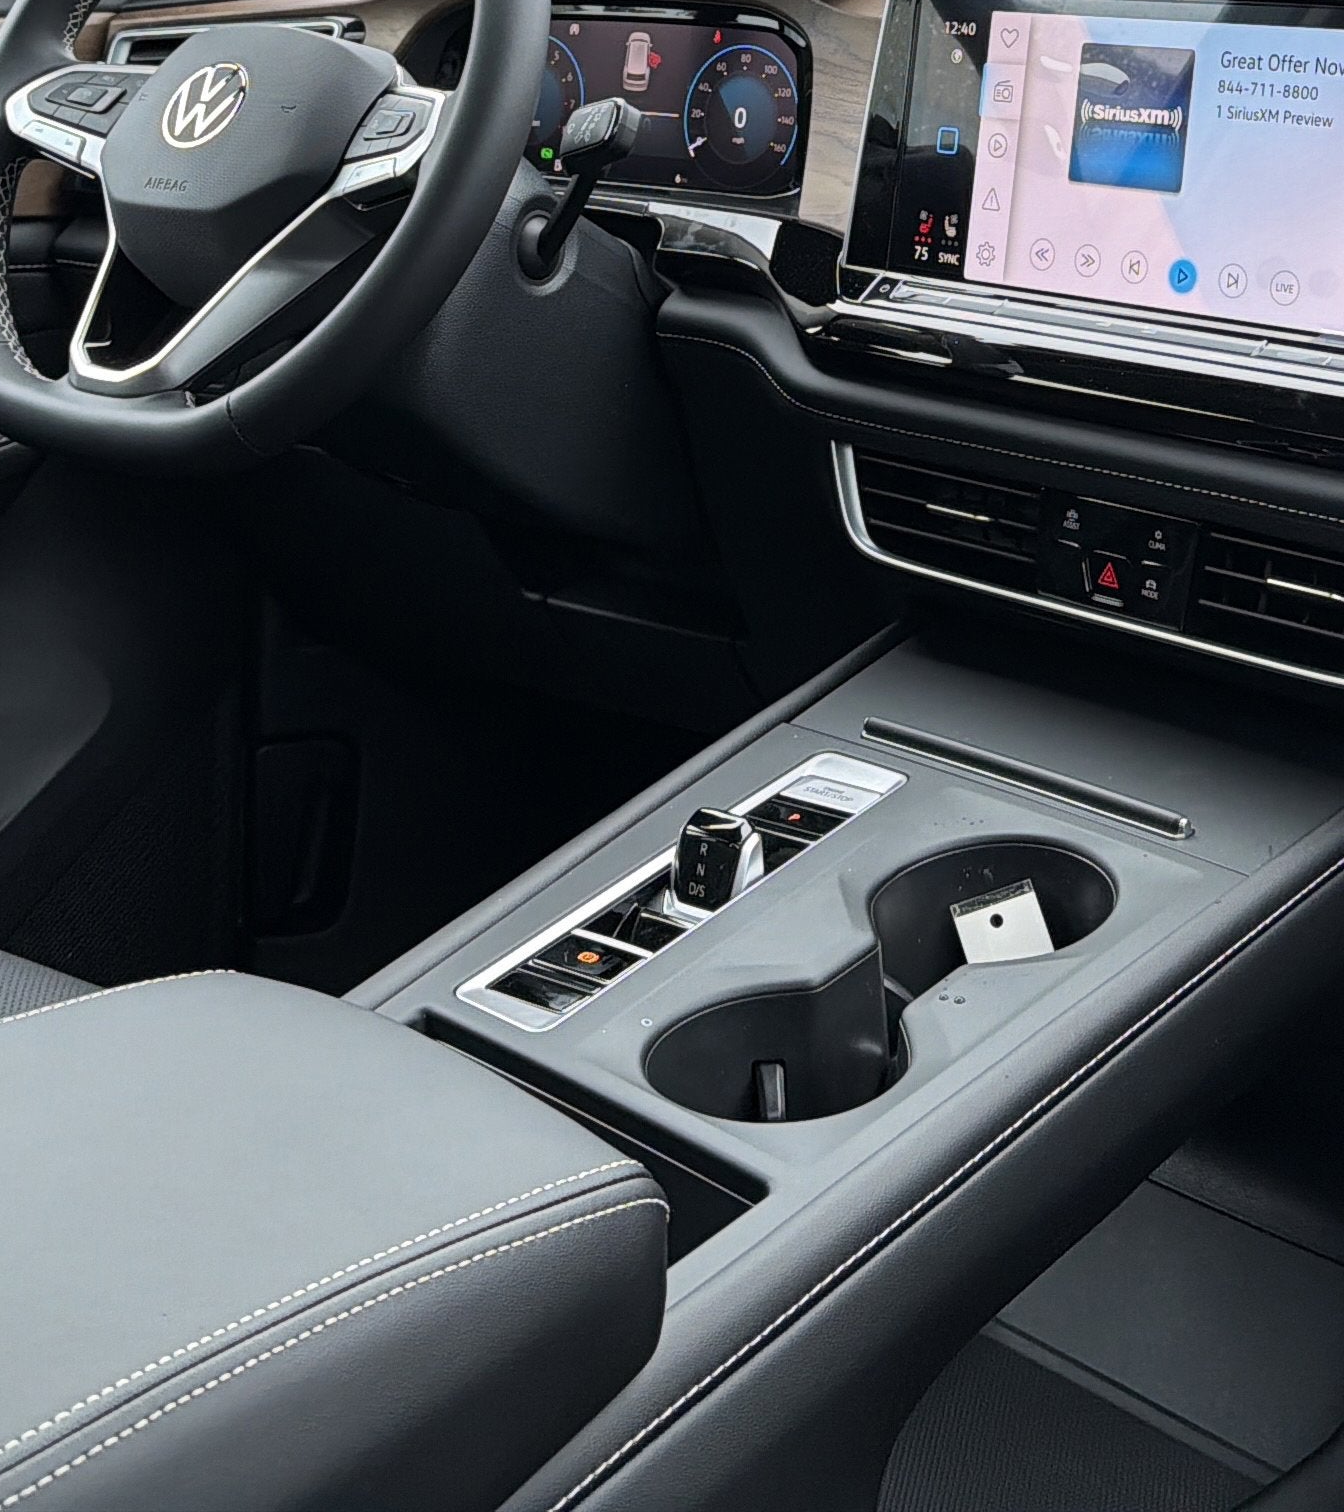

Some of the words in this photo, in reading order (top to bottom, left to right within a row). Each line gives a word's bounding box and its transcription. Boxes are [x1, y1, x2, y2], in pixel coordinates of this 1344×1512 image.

[944, 21, 977, 36] 12:40
[740, 53, 752, 64] 80
[1220, 50, 1264, 71] Great
[1267, 54, 1311, 74] Offer
[716, 61, 727, 73] 60
[763, 64, 778, 75] 100
[777, 87, 792, 98] 120
[1217, 79, 1319, 101] 844-711-8800
[690, 108, 702, 119] 20
[732, 106, 748, 130] 0
[781, 115, 795, 126] 140
[1226, 105, 1280, 124] SiriusXM
[1283, 109, 1334, 128] Preview
[772, 142, 787, 154] 160
[143, 176, 190, 192] AIRBAG
[913, 245, 929, 262] 75
[938, 251, 960, 266] SYNC
[1275, 282, 1295, 295] LIVE
[700, 841, 707, 856] R
[696, 861, 705, 877] N
[688, 880, 706, 899] D/S
